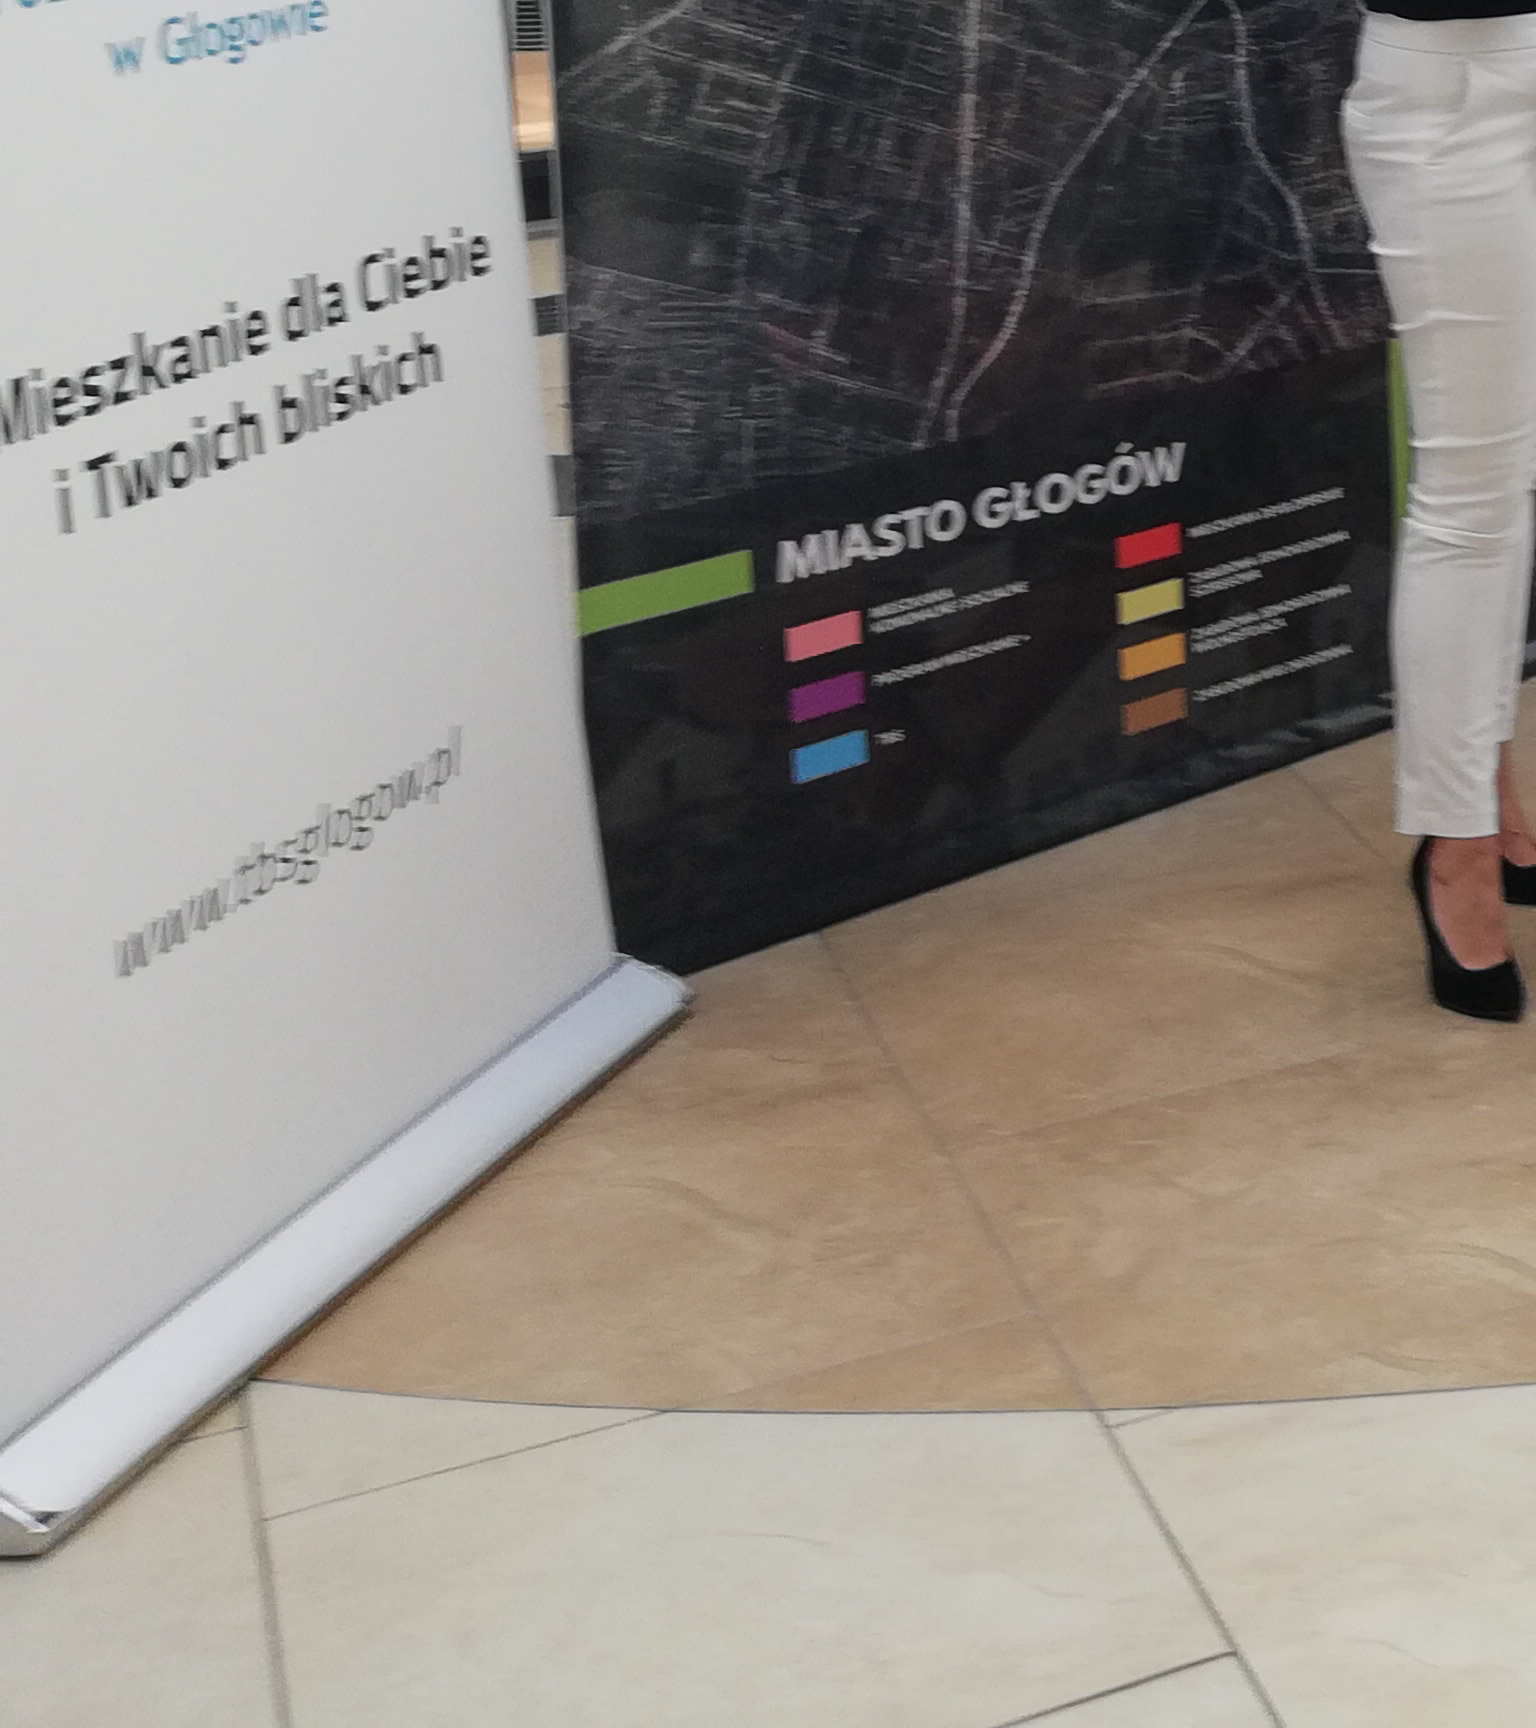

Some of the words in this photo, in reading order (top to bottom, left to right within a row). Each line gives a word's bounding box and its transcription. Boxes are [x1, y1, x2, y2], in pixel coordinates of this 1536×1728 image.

[103, 35, 147, 76] w
[0, 300, 272, 446] Mieszkanie
[280, 272, 350, 342] dla
[357, 226, 494, 313] Ciebie
[53, 467, 77, 535] i
[79, 399, 267, 520] Twoich
[272, 330, 445, 445] bliskich
[775, 498, 967, 583] MIASTO
[971, 441, 1187, 529] GŁOGÓW
